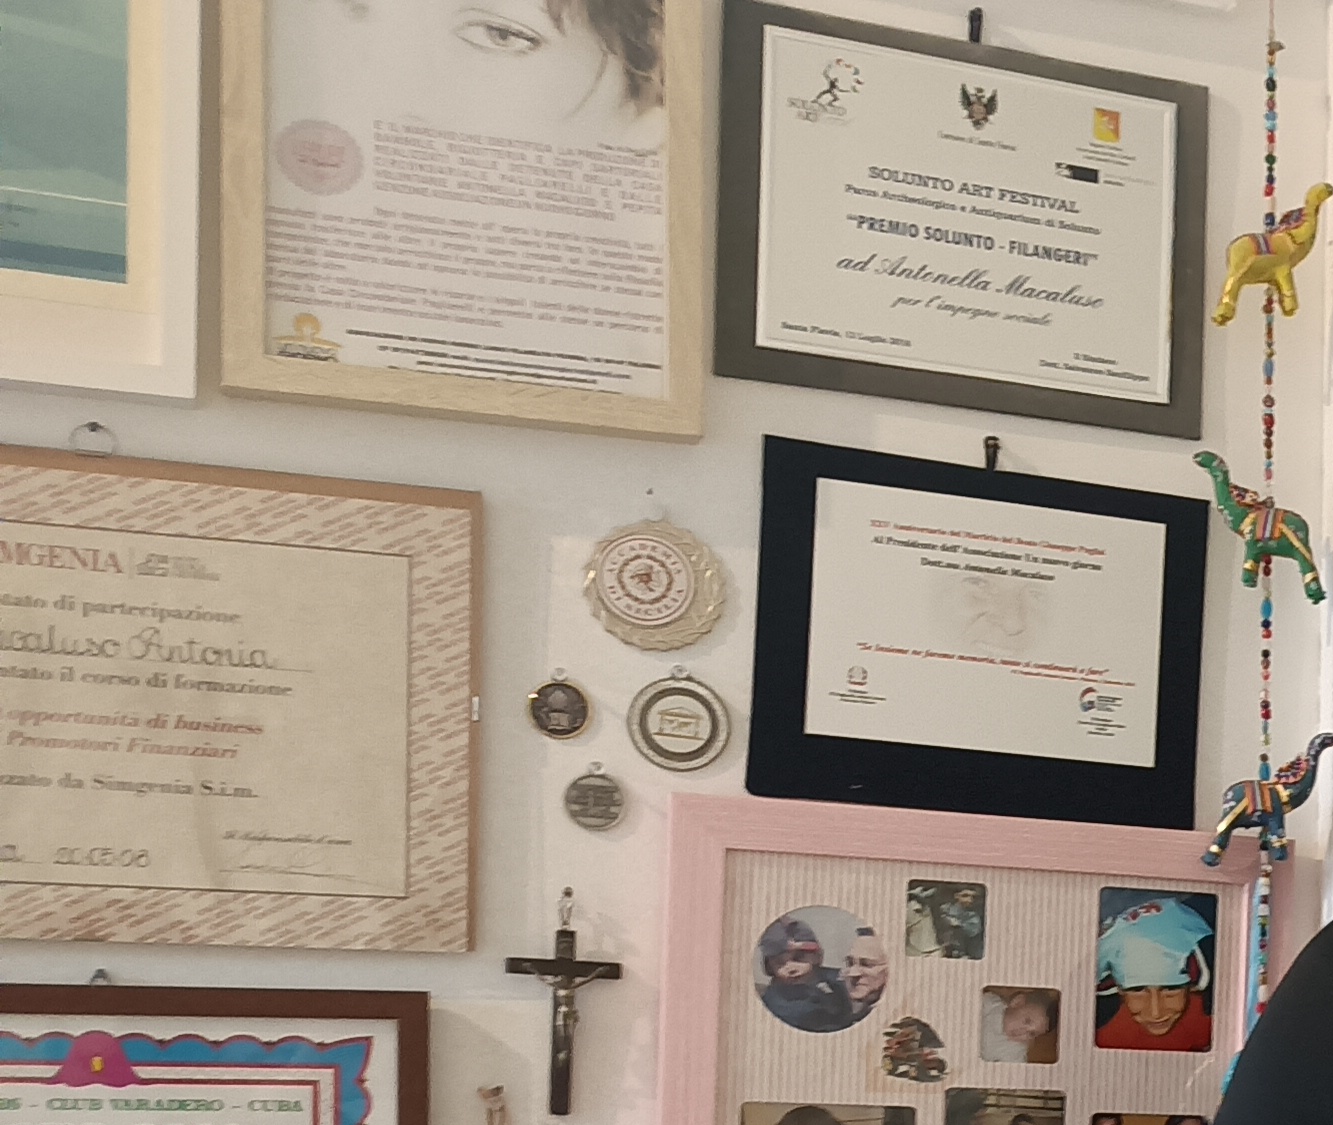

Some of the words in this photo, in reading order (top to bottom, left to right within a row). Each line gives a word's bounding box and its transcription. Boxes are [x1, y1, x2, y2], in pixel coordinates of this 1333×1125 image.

[868, 166, 955, 192] SOLUNTO
[958, 182, 994, 200] ART
[998, 188, 1080, 214] FESTIVAL
[924, 226, 995, 250] SOLUNTO
[836, 253, 877, 272] ad
[874, 256, 991, 292] Antonella
[995, 274, 1104, 308] Macaluso
[53, 594, 76, 611] di
[82, 600, 243, 623] partecipazione
[80, 671, 140, 686] corso
[146, 672, 168, 688] di
[174, 672, 293, 695] formazione
[147, 712, 168, 730] di
[174, 714, 264, 735] business
[109, 1098, 224, 1112] VARADERO
[247, 1098, 303, 1112] CUBA
